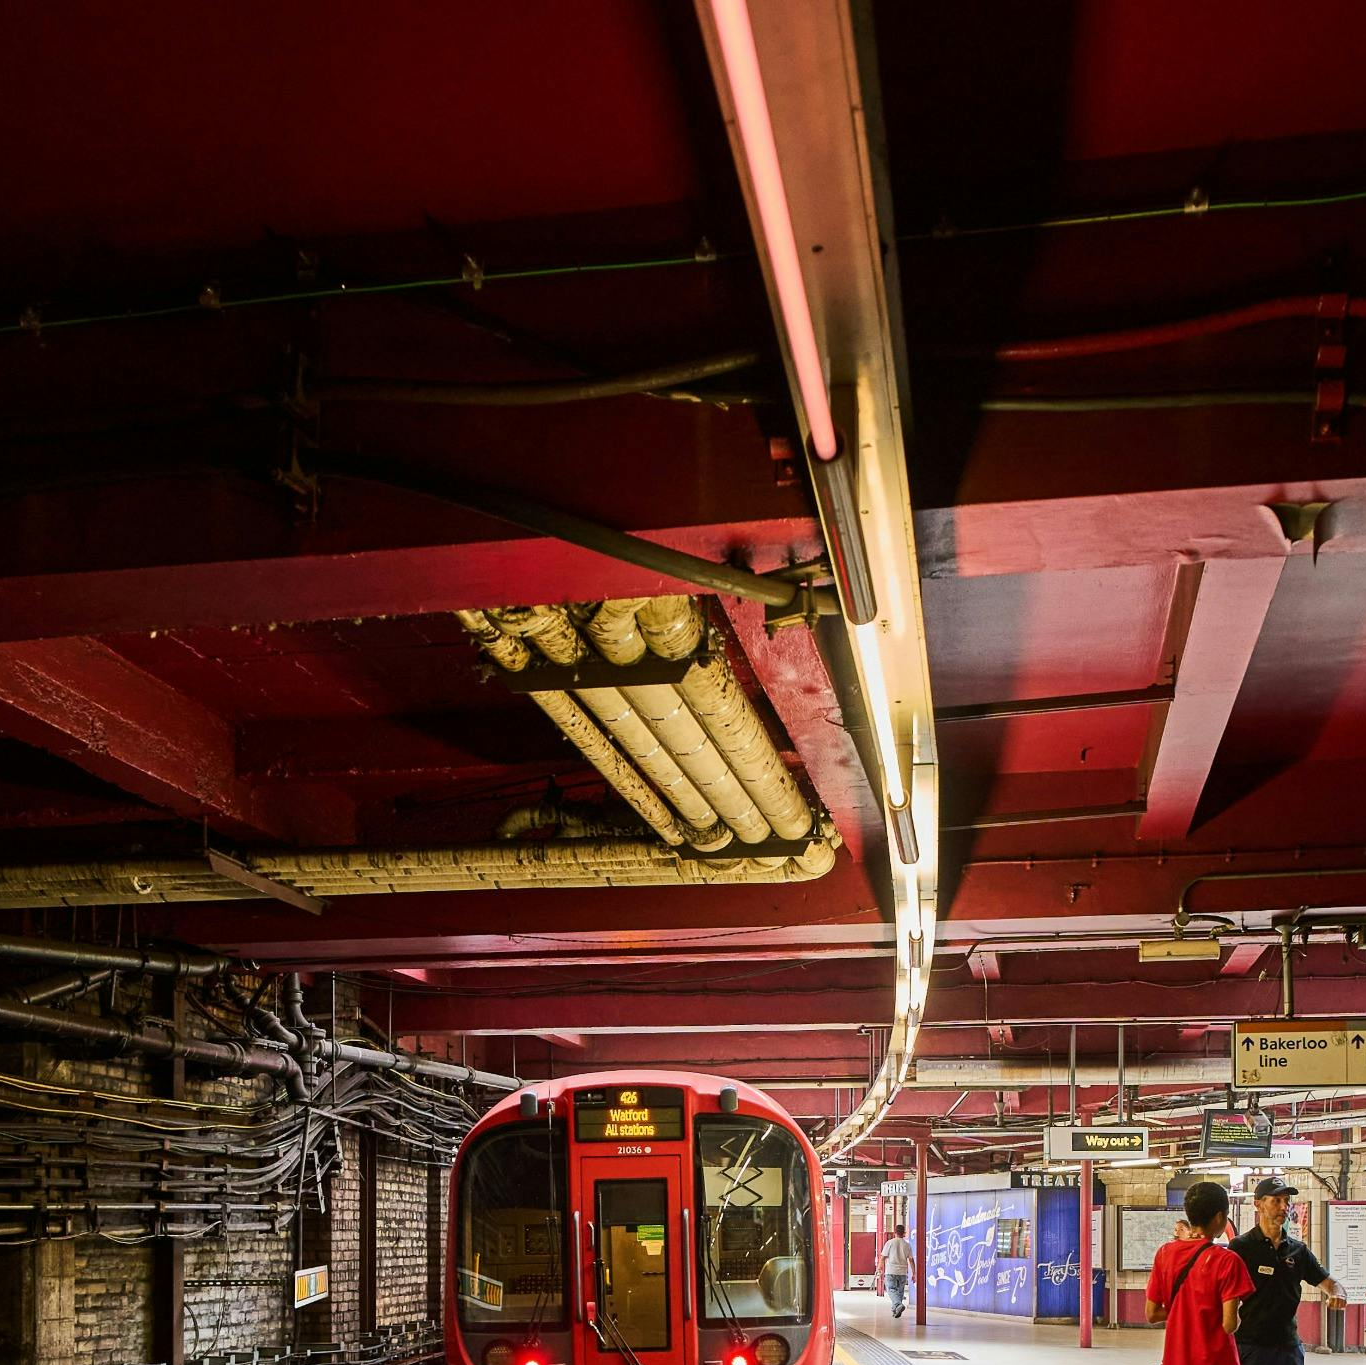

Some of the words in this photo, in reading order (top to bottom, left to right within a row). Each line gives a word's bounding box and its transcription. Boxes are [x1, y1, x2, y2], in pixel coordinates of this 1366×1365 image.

[1259, 1036, 1328, 1051] Bakerloo
[1259, 1054, 1288, 1068] line
[620, 1091, 638, 1105] 426
[609, 1108, 649, 1122] Watford
[604, 1123, 619, 1137] All
[619, 1123, 655, 1137] stations
[1085, 1135, 1110, 1149] Way
[1110, 1135, 1130, 1146] out
[617, 1146, 643, 1155] 21036
[960, 1200, 1002, 1230] handmade
